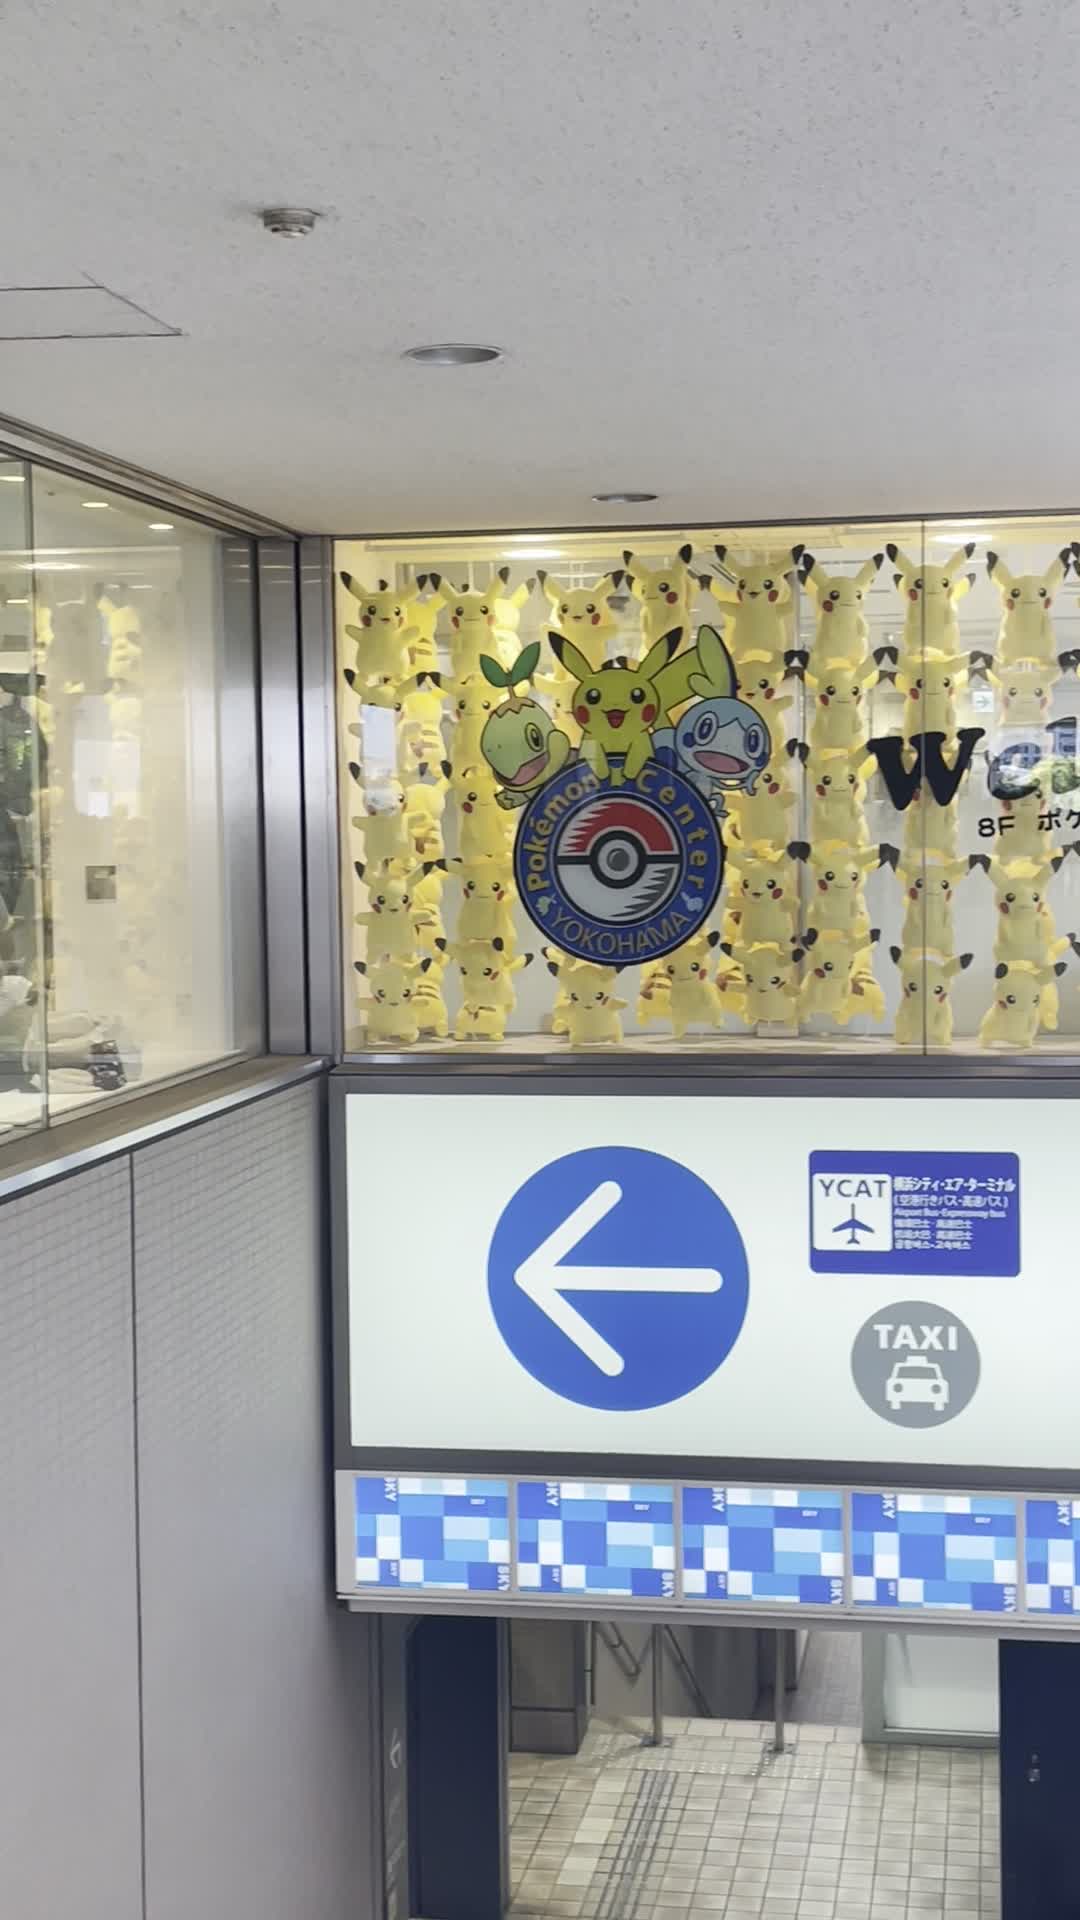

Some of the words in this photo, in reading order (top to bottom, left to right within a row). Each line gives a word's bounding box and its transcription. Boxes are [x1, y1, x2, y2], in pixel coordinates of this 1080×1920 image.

[523, 772, 599, 892] Pokémon
[636, 769, 709, 890] Center
[978, 815, 1015, 837] 8F
[550, 907, 691, 955] YOKOHAMA
[819, 1179, 888, 1198] YCAT
[873, 1324, 958, 1351] TAXI
